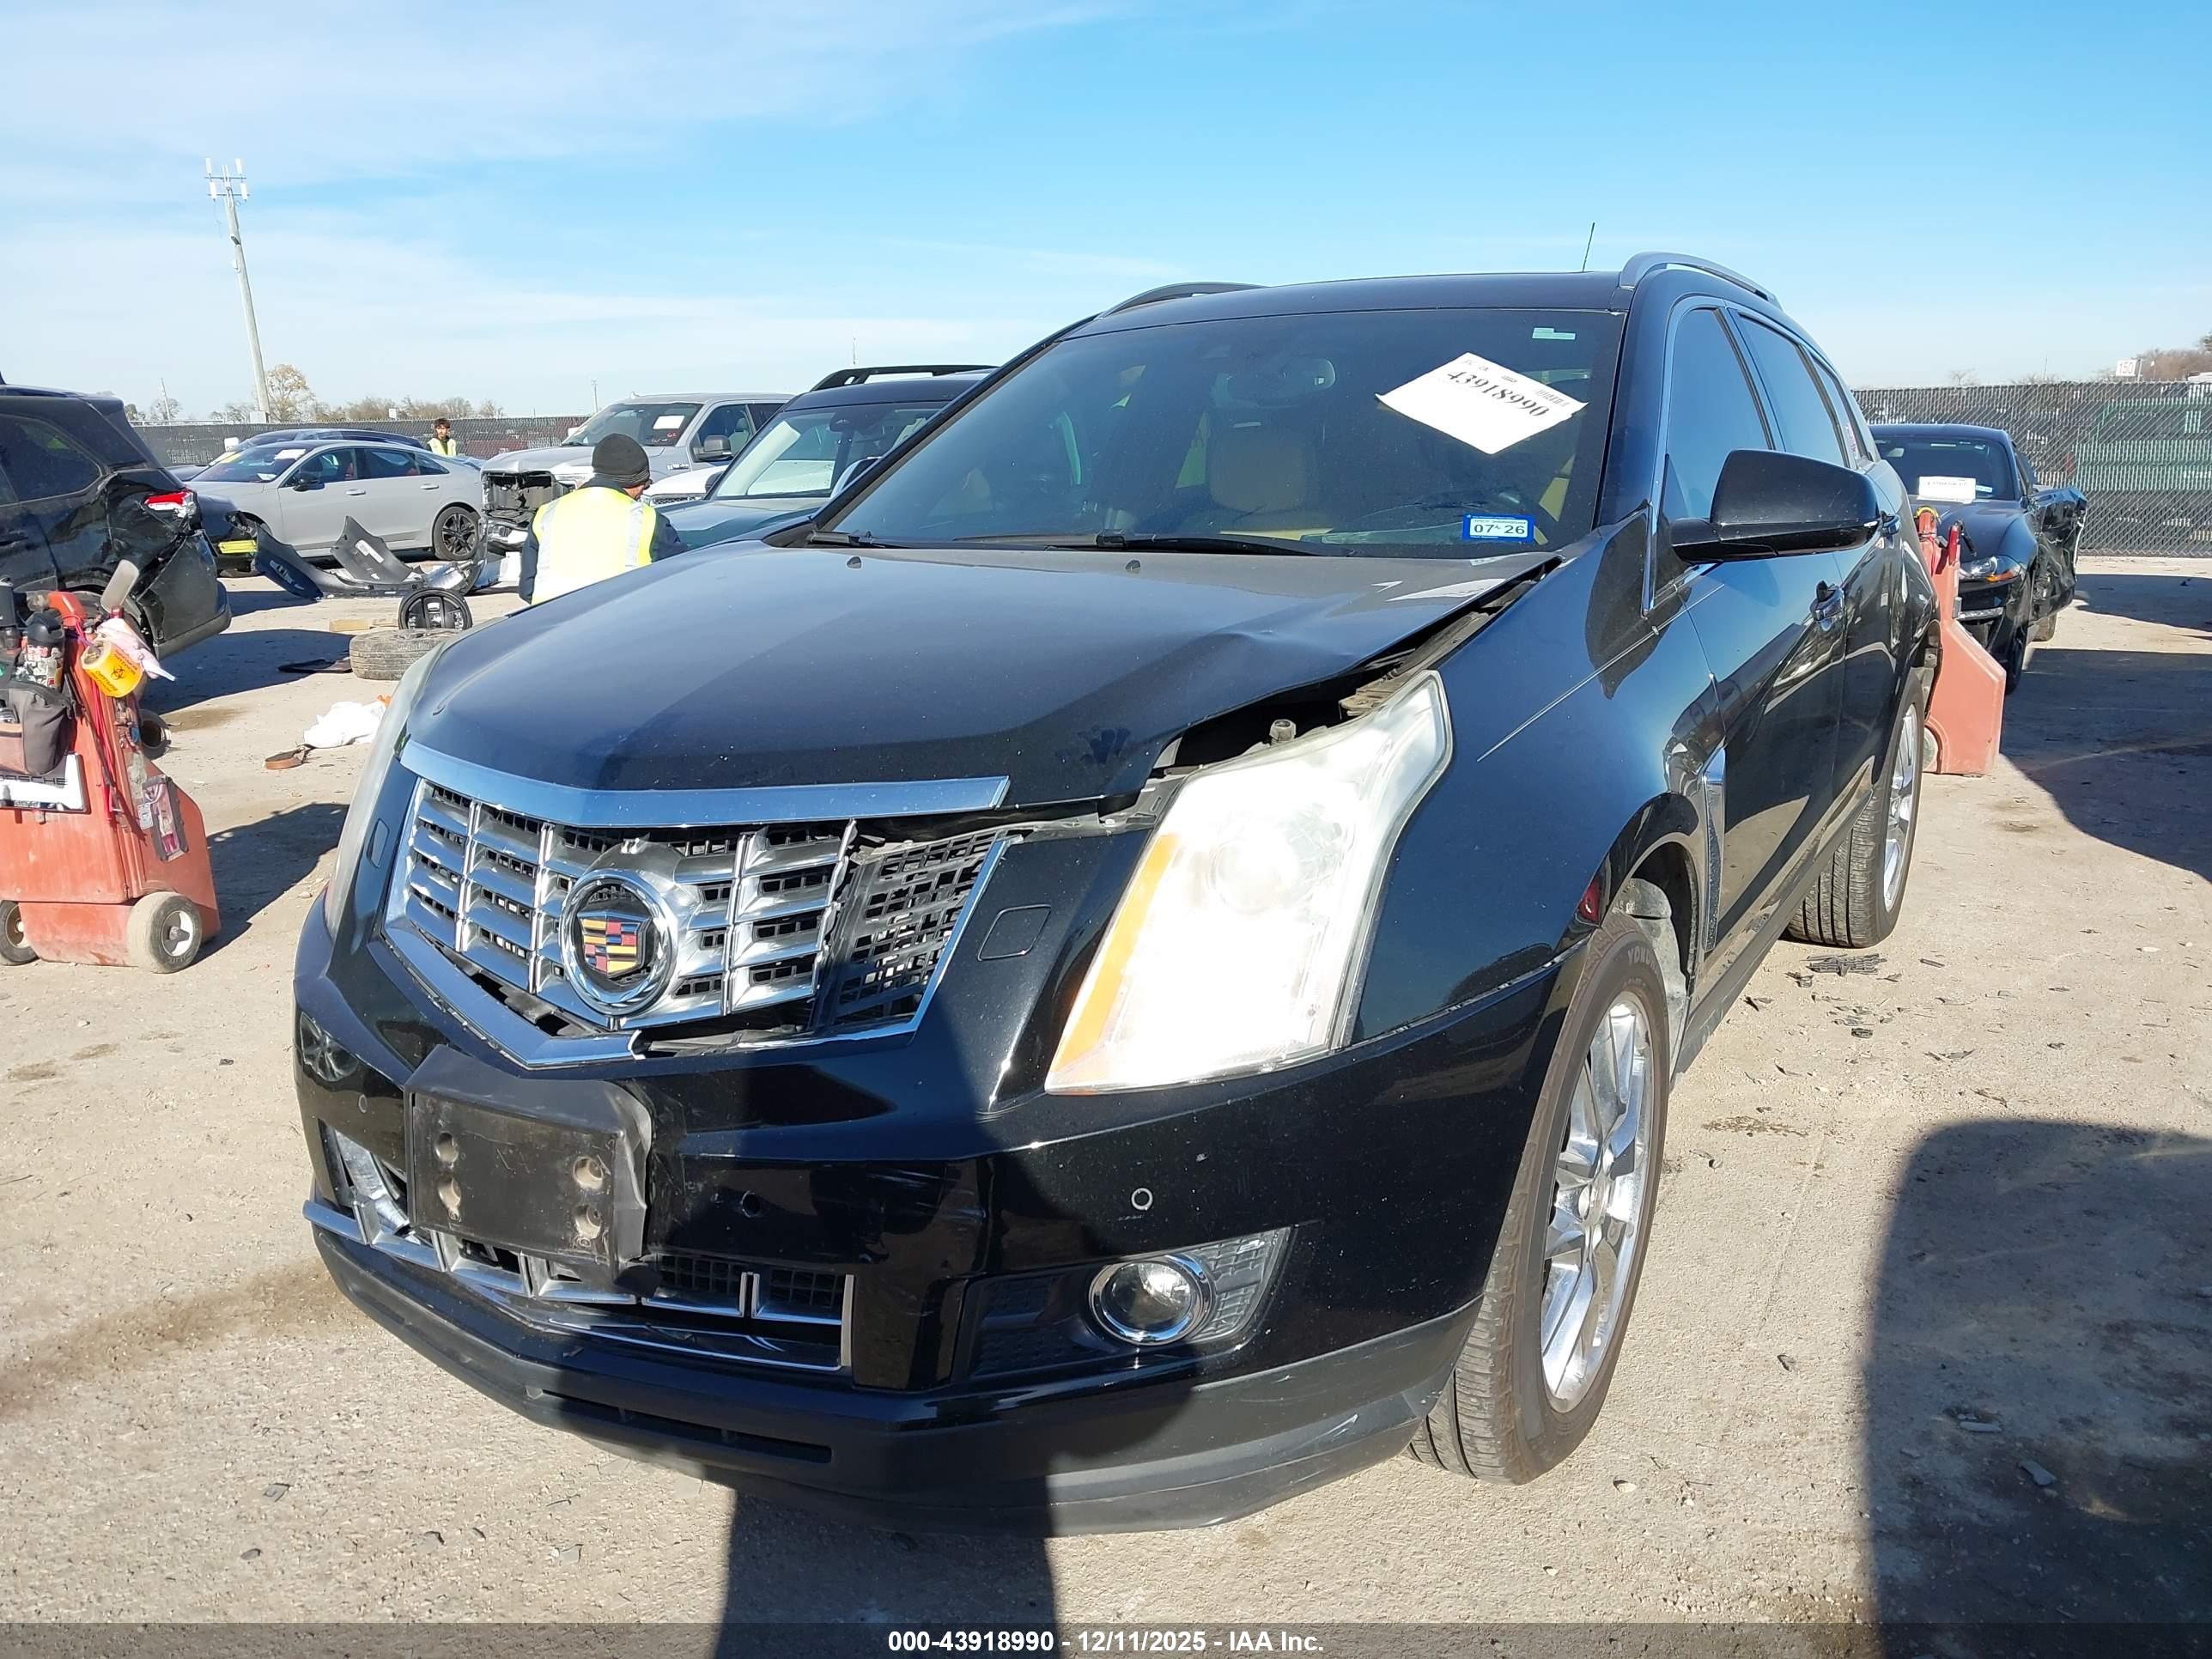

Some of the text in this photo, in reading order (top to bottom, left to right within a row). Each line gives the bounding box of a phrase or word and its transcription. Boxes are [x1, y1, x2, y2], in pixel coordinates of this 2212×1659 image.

[1448, 371, 1550, 416] 43918990
[1474, 524, 1525, 534] 07 26
[0, 775, 69, 786] RSCHE
